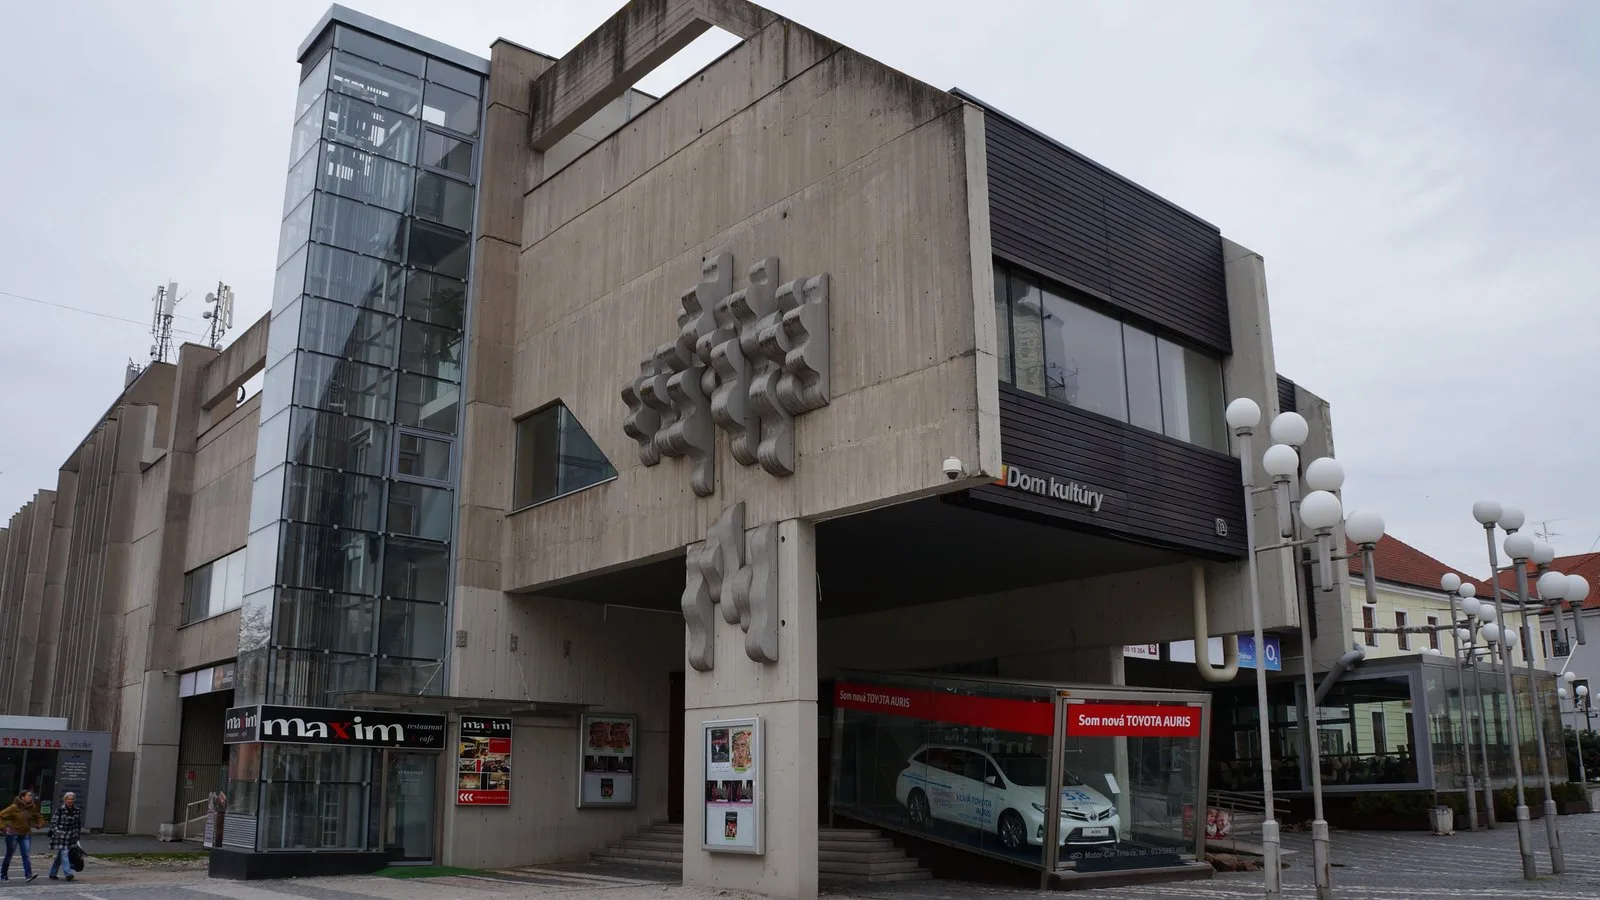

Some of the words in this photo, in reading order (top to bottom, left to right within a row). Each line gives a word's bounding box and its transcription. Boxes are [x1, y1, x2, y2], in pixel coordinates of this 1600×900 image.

[1007, 466, 1046, 495] Dom
[1050, 477, 1103, 512] kultúry
[840, 690, 852, 701] Som
[852, 692, 866, 702] nová
[867, 693, 890, 705] TOYOTA
[890, 696, 910, 708] AURIS
[227, 712, 257, 730] maxim
[262, 716, 405, 741] maxim
[463, 721, 510, 730] maxim
[1078, 714, 1100, 727] Som
[1102, 714, 1125, 727] nová
[1126, 715, 1163, 727] TOYOTA
[1163, 715, 1191, 728] AURIS
[3, 738, 62, 748] TRAFIKA
[971, 797, 992, 808] TOYOTA
